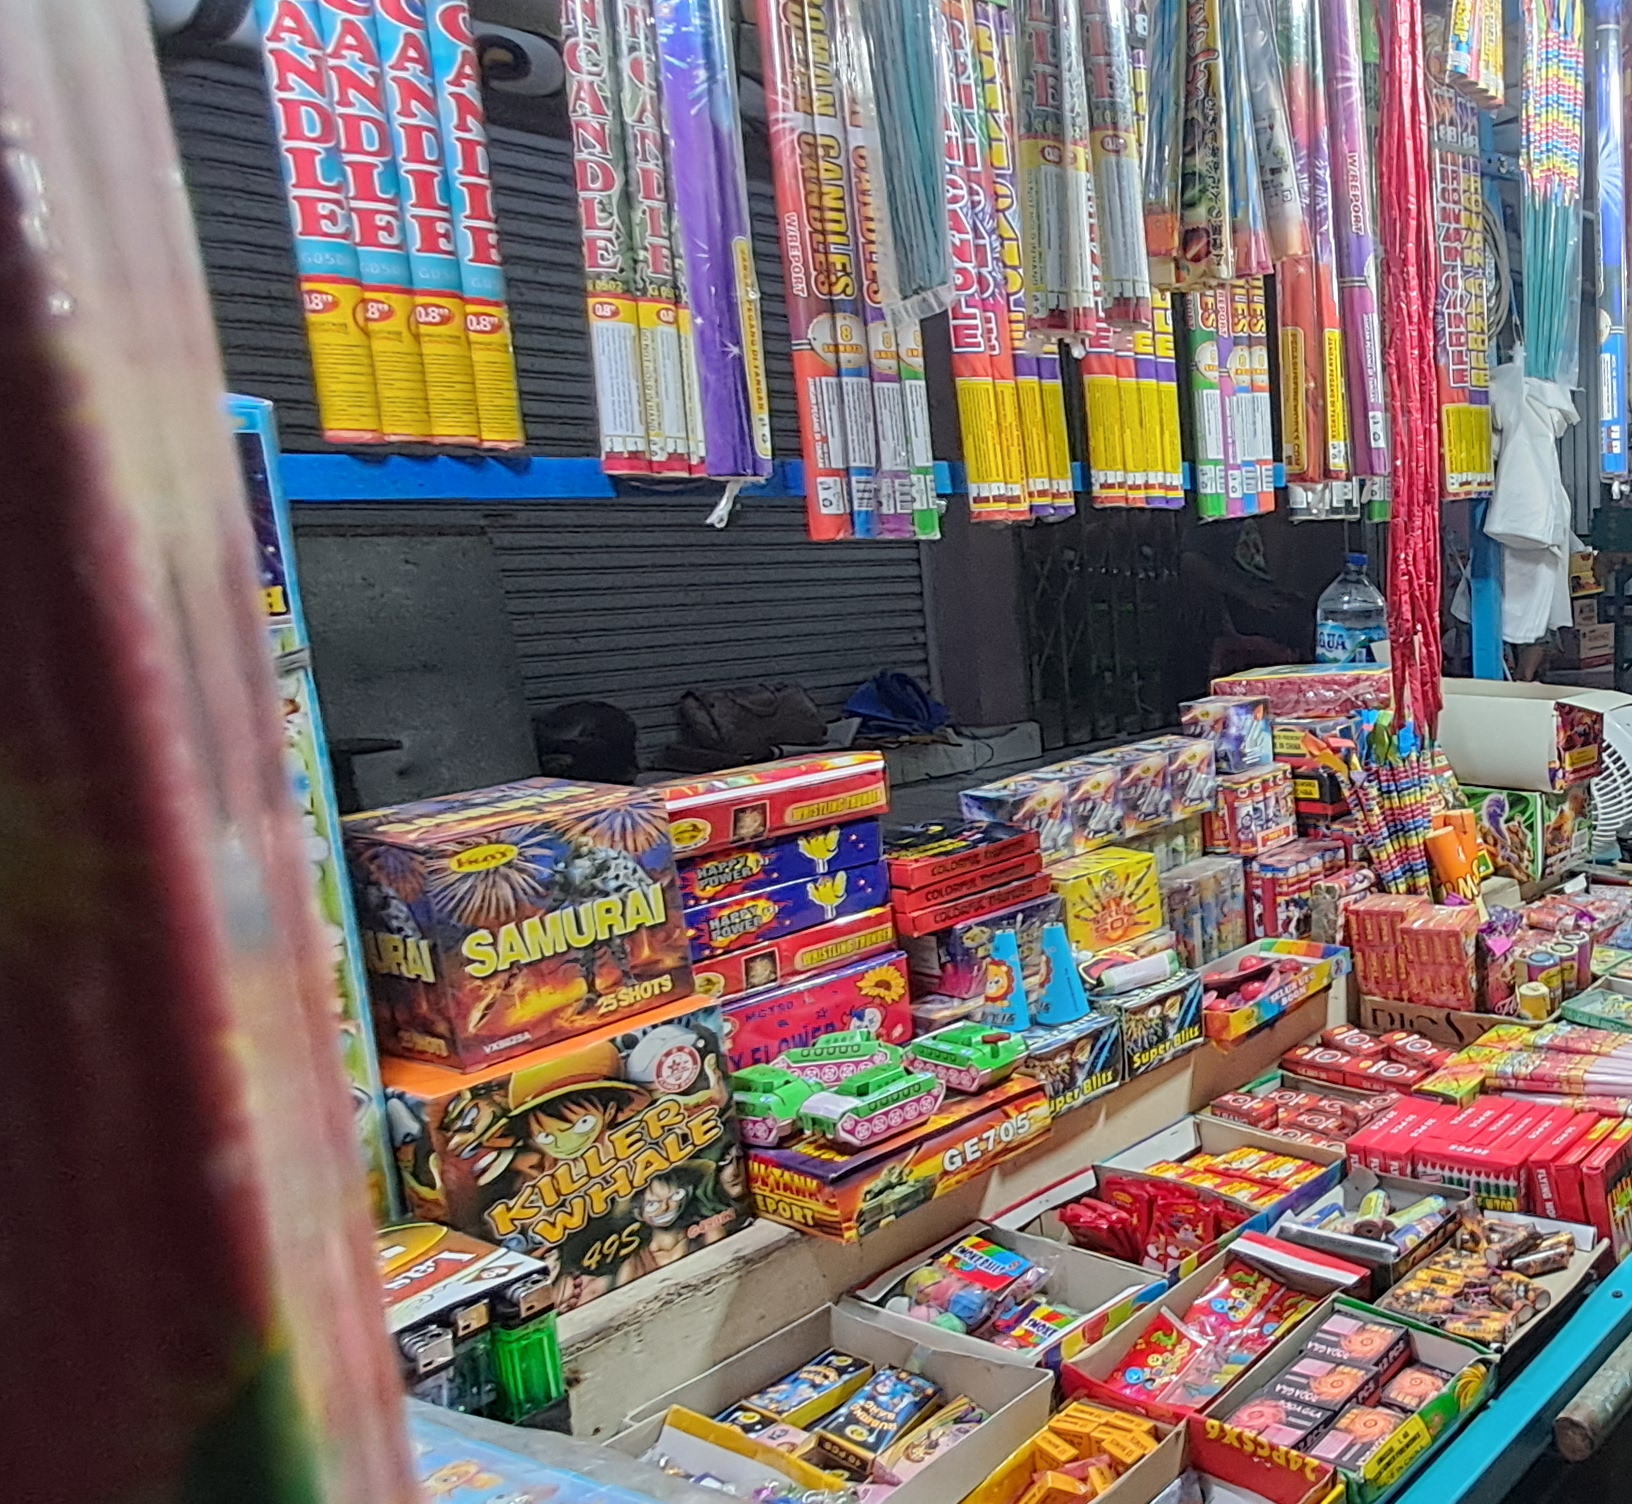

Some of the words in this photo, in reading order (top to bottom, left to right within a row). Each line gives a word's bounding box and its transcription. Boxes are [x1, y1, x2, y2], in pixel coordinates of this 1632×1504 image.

[266, 0, 352, 242] ANDLE
[1347, 150, 1364, 236] W/REPORT
[784, 211, 808, 298] W/REPORT
[1318, 631, 1348, 651] QUA
[697, 855, 750, 881] HAPPY
[698, 867, 752, 890] POWER
[461, 881, 668, 979] SAMURAI
[707, 903, 759, 931] HAPPY
[710, 916, 763, 940] POWER
[365, 930, 437, 984] URAI
[597, 995, 619, 1015] 25
[616, 974, 674, 1007] SHOTS
[1132, 1040, 1173, 1070] Super
[1173, 1025, 1201, 1050] Blitz
[1048, 1086, 1081, 1114] uper
[1083, 1069, 1115, 1095] Blitz
[942, 1112, 1032, 1173] GE705
[484, 1096, 687, 1240] KILLER
[528, 1104, 724, 1247] WHALE
[755, 1194, 816, 1227] EPORT
